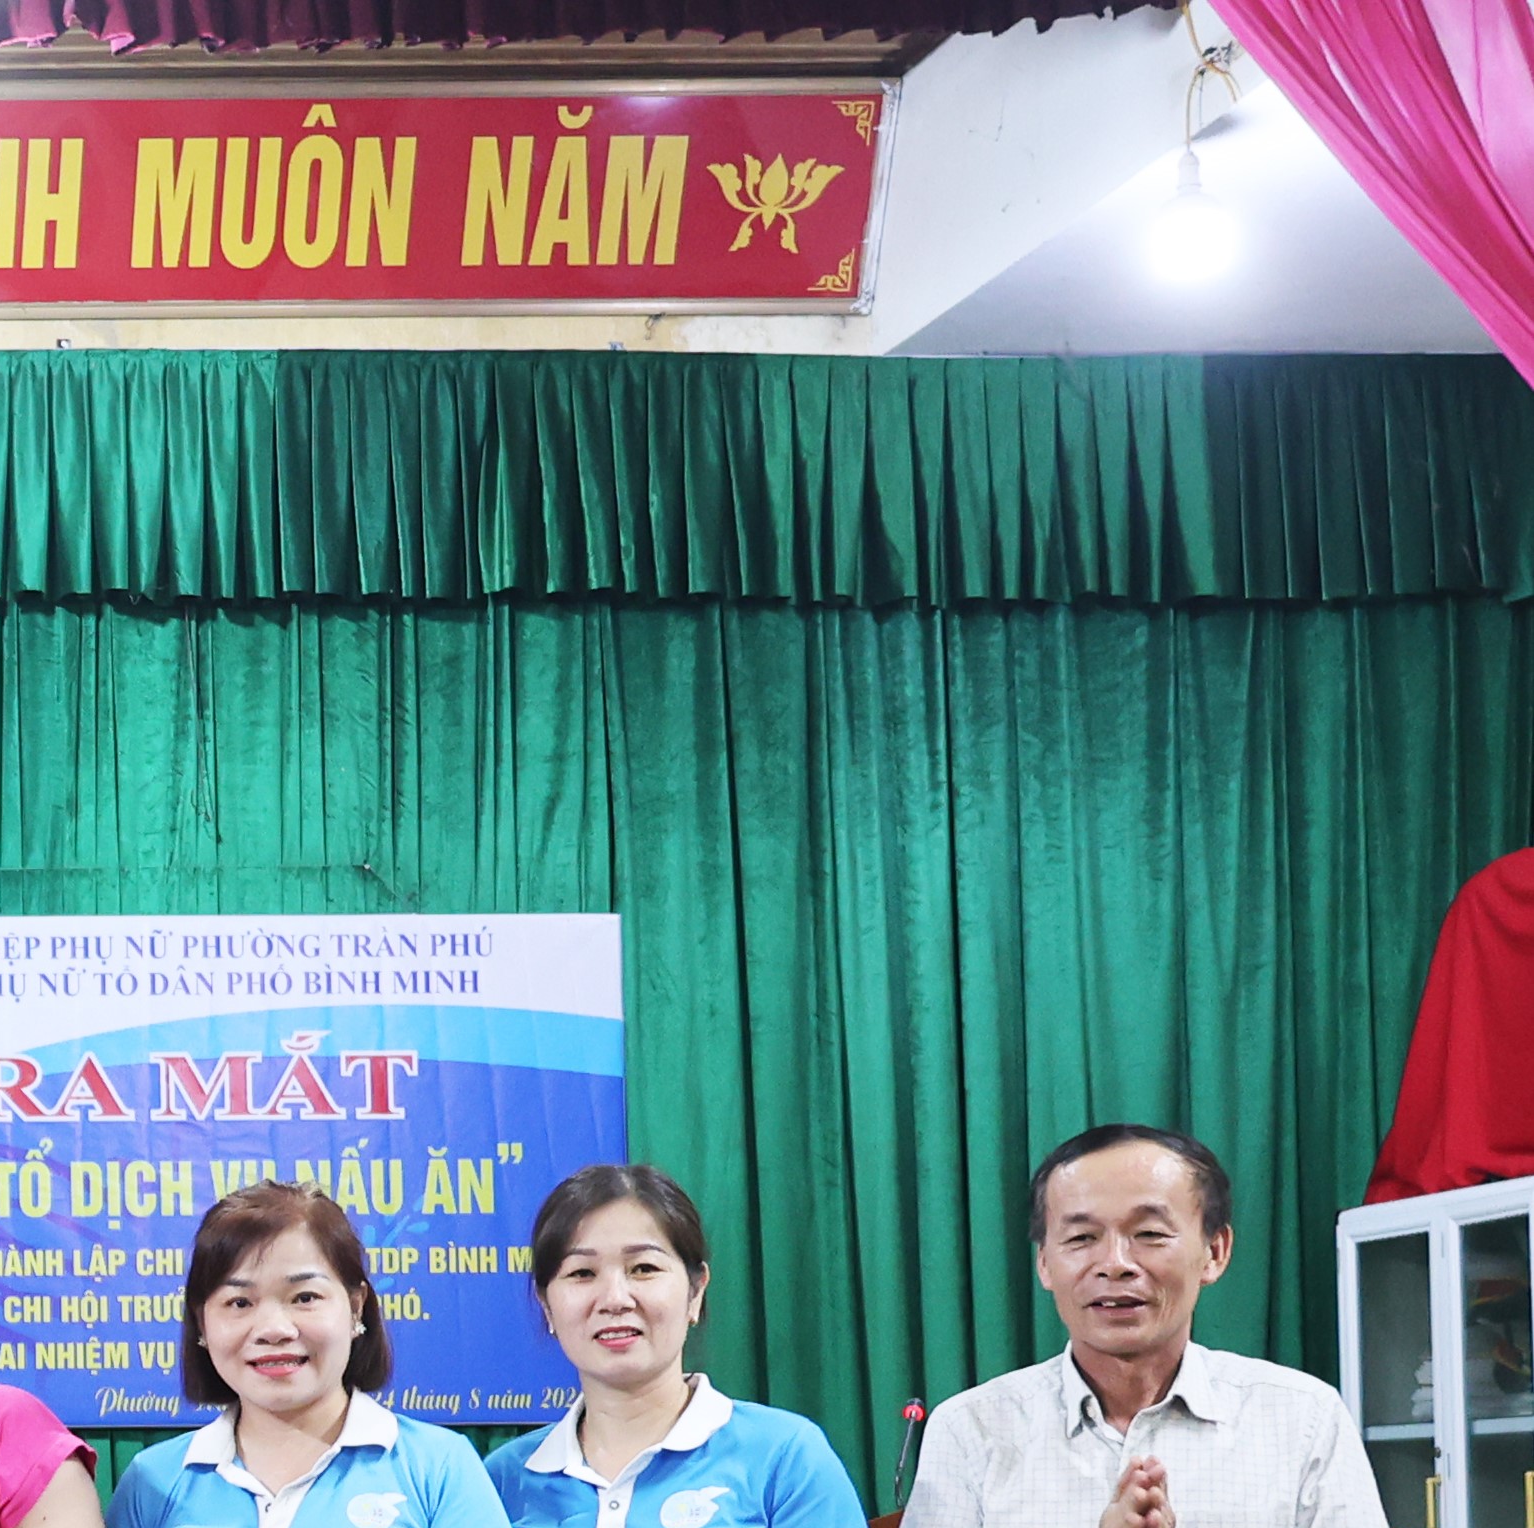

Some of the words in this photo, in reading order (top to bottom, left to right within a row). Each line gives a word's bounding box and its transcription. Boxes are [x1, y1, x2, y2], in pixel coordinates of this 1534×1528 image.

[129, 104, 418, 270] MUÔN
[458, 105, 689, 267] NĂM
[49, 934, 114, 966] PHỤ
[124, 928, 174, 960] NỮ
[181, 927, 322, 959] PHƯỜNG
[429, 925, 495, 957] PHÚ
[37, 966, 87, 997] NỮ
[148, 964, 216, 997] DÂN
[303, 963, 381, 996] BÌNH
[392, 969, 482, 995] MINH
[150, 1029, 418, 1122] MẮT
[70, 1159, 195, 1230] DỊCH
[73, 1242, 127, 1283] LẬP
[136, 1248, 185, 1277] CHI
[365, 1246, 420, 1275] TDP
[429, 1240, 499, 1275] BÌNH
[3, 1295, 52, 1323] CHI
[60, 1289, 110, 1329] HỘI
[377, 1287, 431, 1321] HÓ.
[34, 1335, 130, 1376] NHIỆM
[138, 1341, 176, 1376] VỤ
[95, 1386, 181, 1418] Phường
[402, 1385, 462, 1416] tháng
[468, 1387, 482, 1409] 8
[487, 1388, 533, 1410] năm
[540, 1386, 583, 1410] 202
